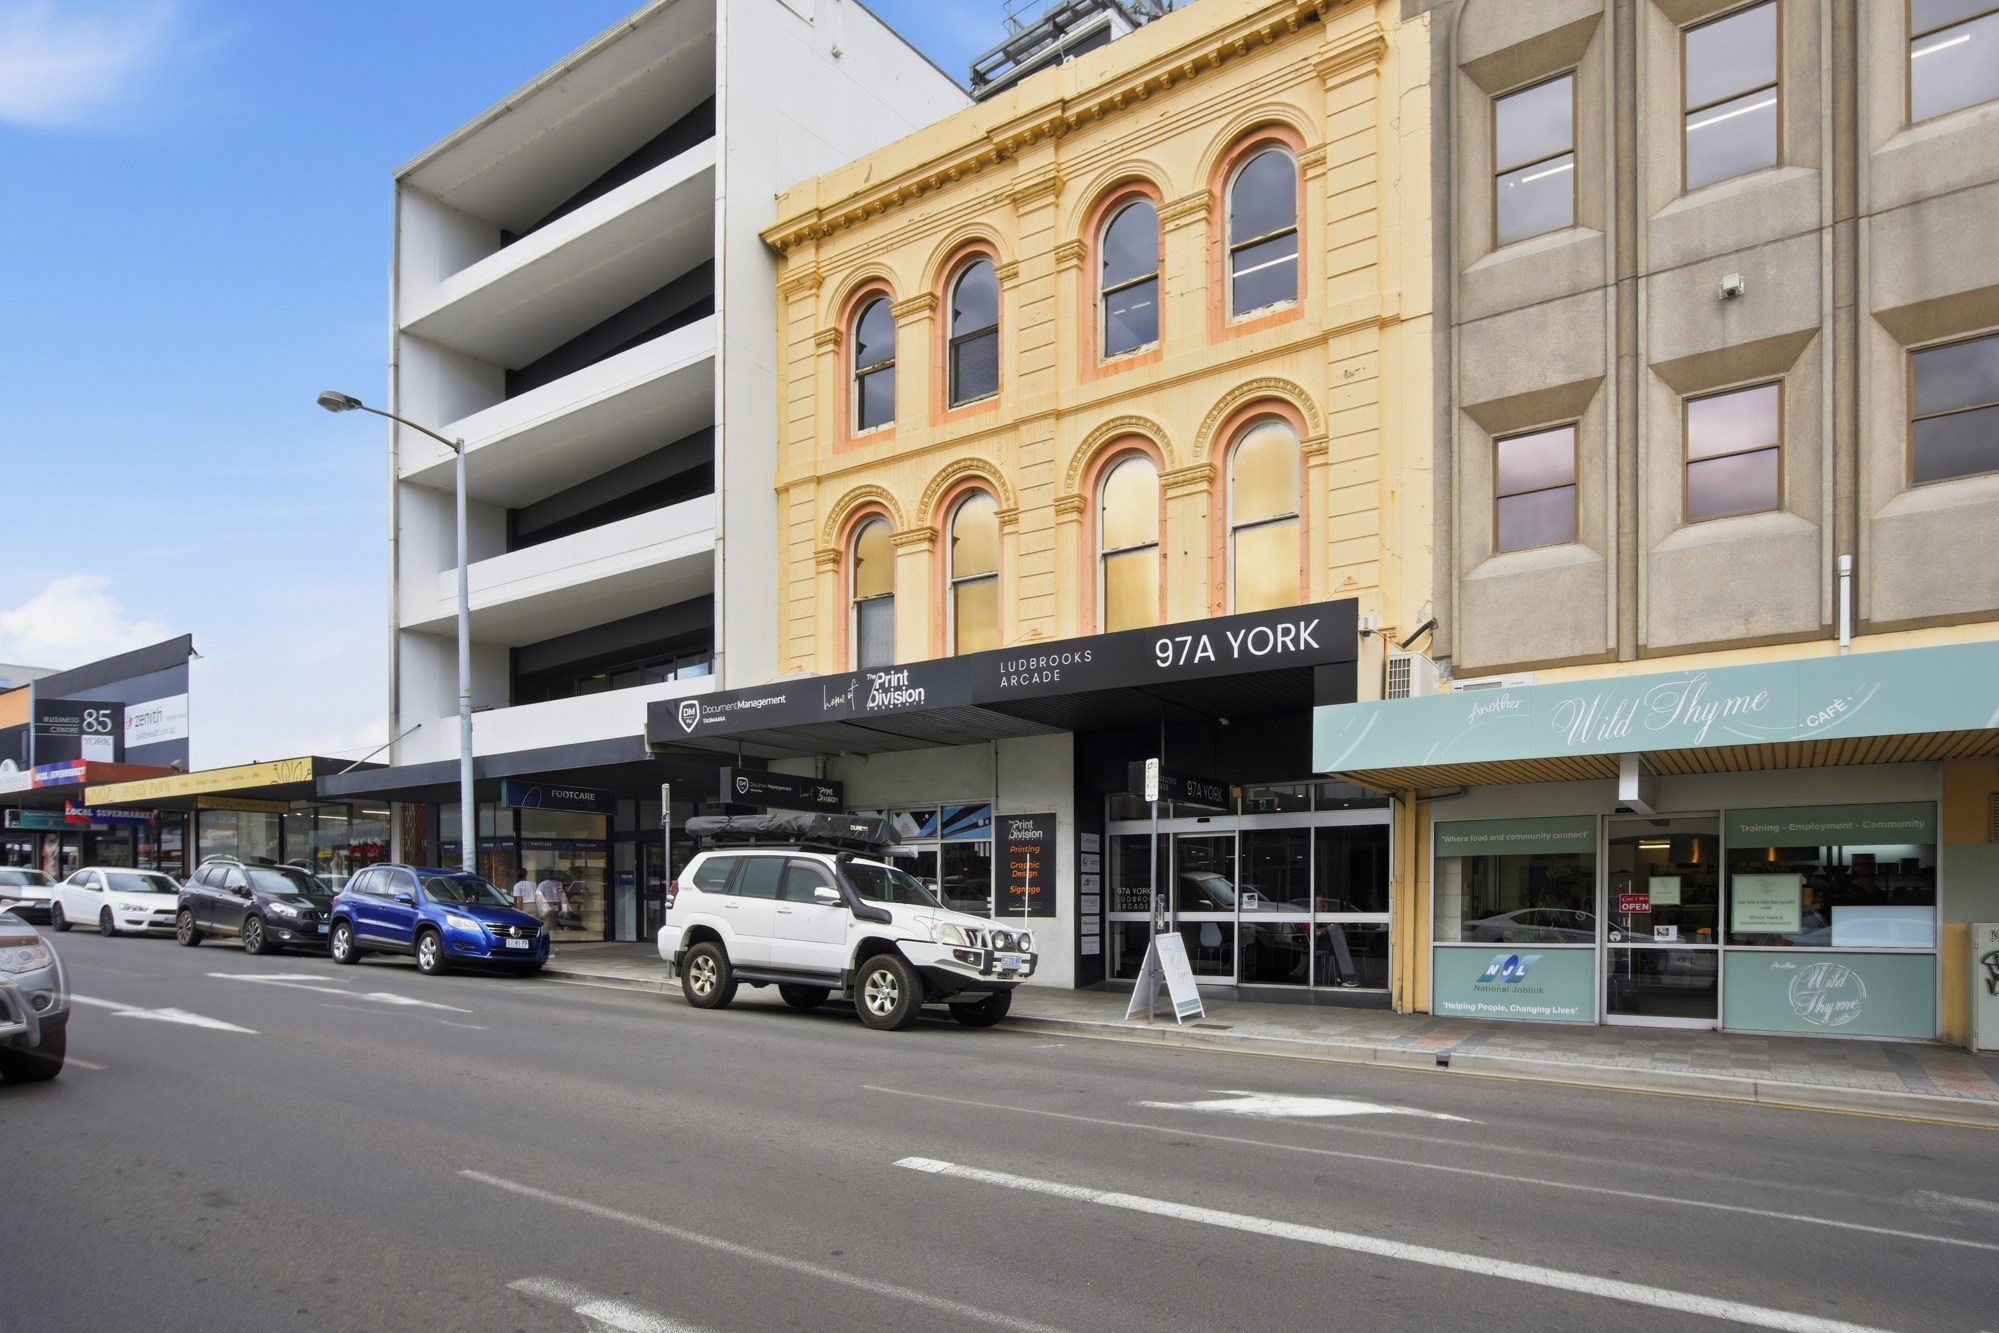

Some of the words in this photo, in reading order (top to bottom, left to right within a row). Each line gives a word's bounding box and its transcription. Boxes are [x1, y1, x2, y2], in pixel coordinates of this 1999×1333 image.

[1155, 634, 1216, 668] 97A
[1226, 619, 1320, 659] YORK
[1000, 650, 1093, 673] LUDBROOKS
[876, 669, 909, 689] Print
[1000, 670, 1061, 688] ARCADE
[847, 678, 859, 711] of
[867, 686, 925, 708] Division
[683, 707, 696, 717] DM
[1468, 693, 1523, 724] Another
[1551, 686, 1641, 746] Wild
[1643, 672, 1770, 745] Thyme
[82, 709, 113, 733] 85
[135, 706, 163, 728] zenith
[83, 737, 112, 746] YORK
[551, 789, 596, 801] FOOTCARE
[1187, 780, 1203, 798] 97A
[1203, 784, 1223, 802] YORK
[65, 807, 94, 817] LOCAL
[96, 809, 156, 820] SUPERMARKET
[1013, 819, 1034, 829] Print
[1740, 823, 1780, 833] Training
[1789, 821, 1853, 832] Employment
[1862, 819, 1926, 830] Community
[1008, 828, 1043, 839] Division
[1470, 834, 1488, 842] food
[1506, 831, 1551, 841] community
[1009, 845, 1041, 855] Printing
[1011, 870, 1038, 878] Desgn
[1621, 902, 1650, 911] OPEN
[1485, 964, 1526, 976] NJL
[1799, 963, 1851, 990] Wild
[1474, 984, 1510, 994] National
[1512, 986, 1544, 995] Joblink
[1477, 1003, 1508, 1013] People,
[1509, 1005, 1551, 1015] Changing
[1793, 987, 1860, 1025] Thyme
